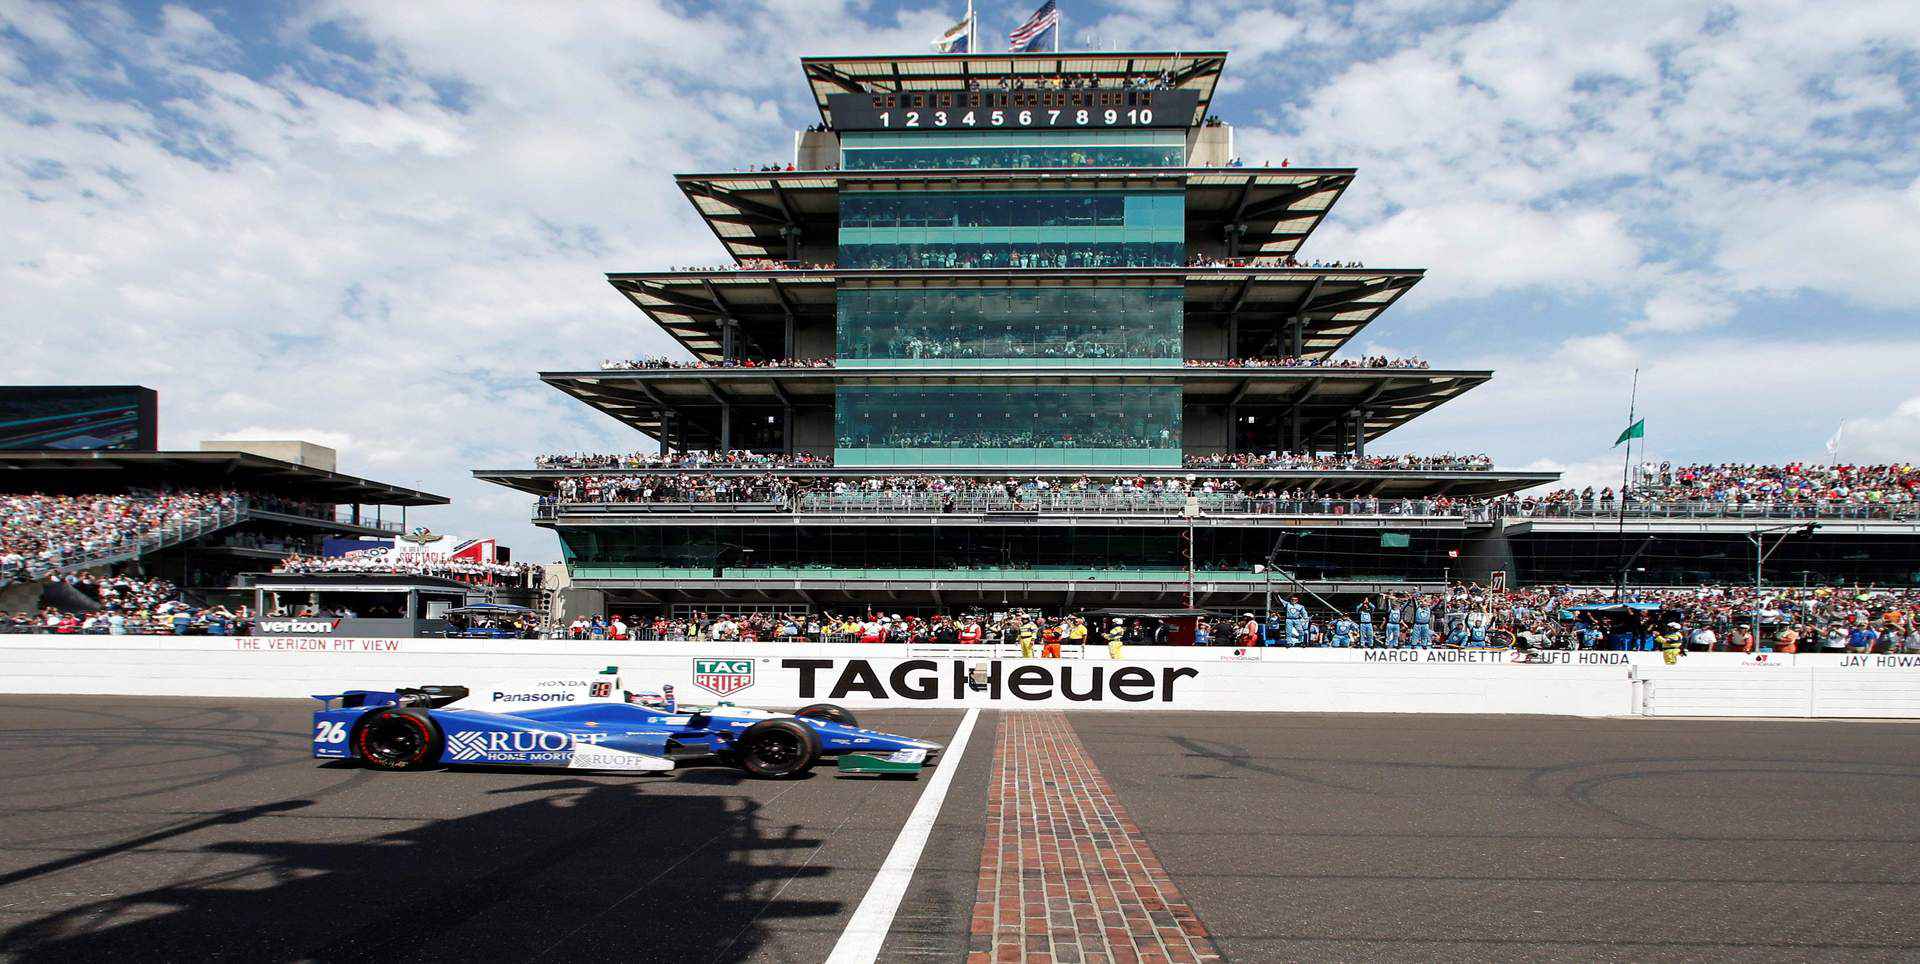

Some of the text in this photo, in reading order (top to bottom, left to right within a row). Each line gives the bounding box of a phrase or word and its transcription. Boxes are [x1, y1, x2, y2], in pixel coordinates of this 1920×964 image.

[880, 110, 1152, 127] 1 2 3 4 5 6 7 8 9 10
[260, 619, 333, 633] verizon
[235, 639, 399, 650] THE VERIZON PIT VIEW
[1364, 650, 1418, 662] MARCO
[1426, 651, 1501, 662] ANDRETTI
[1579, 654, 1630, 664] HONDA
[1840, 656, 1868, 667] JAY
[699, 662, 748, 673] TAG
[697, 675, 749, 693] HEUER
[782, 659, 1199, 702] TAG Heuer
[493, 691, 575, 702] Panasonic
[314, 721, 346, 743] 26
[488, 731, 607, 751] RUOFF
[593, 755, 641, 766] RUOFF
